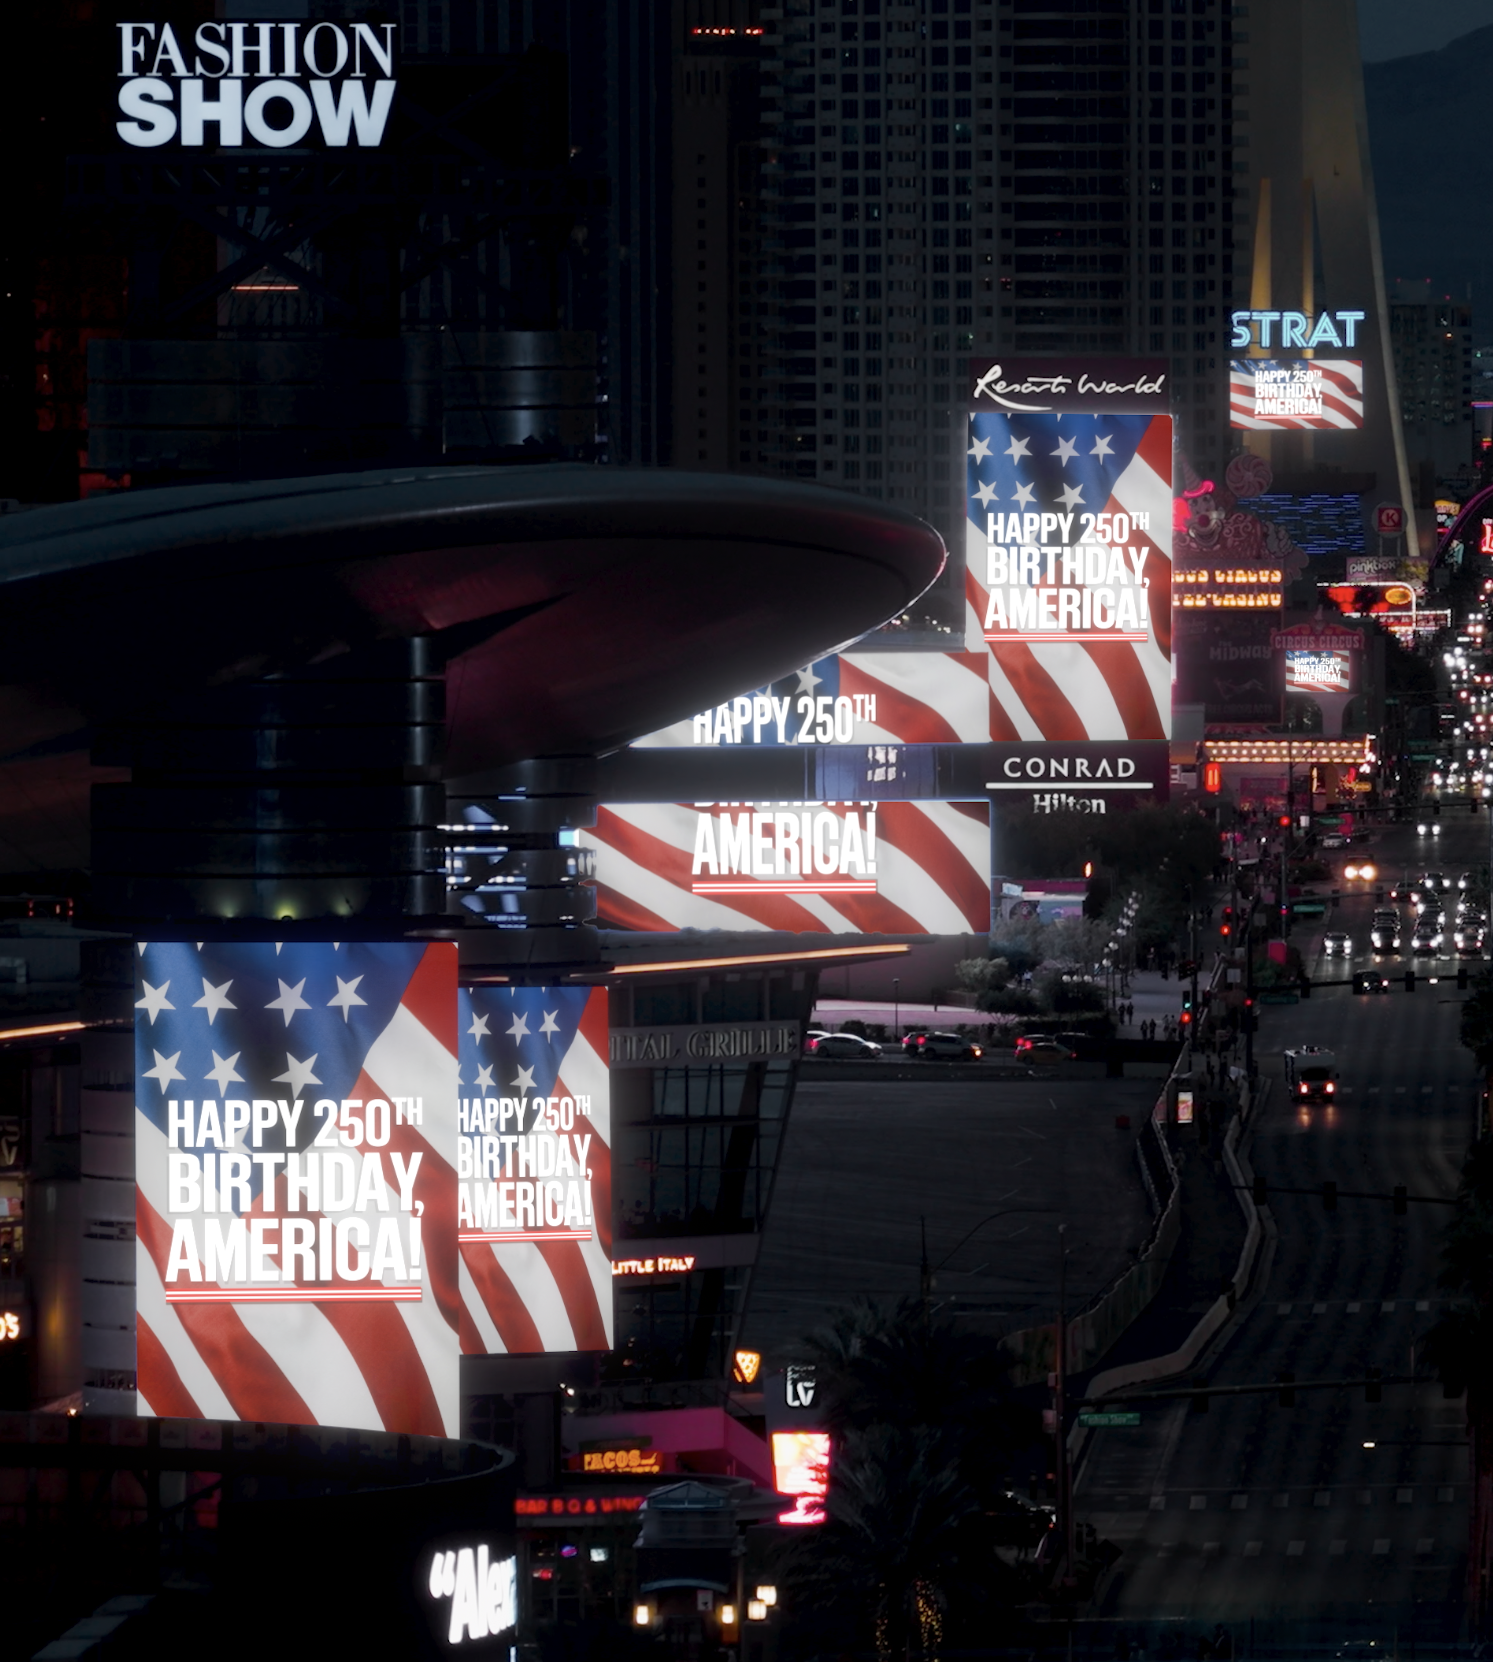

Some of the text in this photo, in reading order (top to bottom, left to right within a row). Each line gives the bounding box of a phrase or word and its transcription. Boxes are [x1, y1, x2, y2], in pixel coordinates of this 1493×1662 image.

[117, 22, 396, 78] FASHION
[117, 77, 396, 147] SHOW
[1231, 311, 1365, 348] STRAT
[974, 363, 1166, 411] Resorts World
[1255, 370, 1291, 382] HAPPY
[1255, 382, 1323, 399] BIRTHDAY,
[1254, 399, 1322, 415] AMERICA!
[987, 513, 1074, 544] HAPPY
[987, 547, 1150, 588] BIRTHDAY,
[1349, 559, 1396, 575] pinkbox
[984, 588, 1148, 629] AMERICA!
[1274, 635, 1360, 648] CIRCUS CIRCUS
[693, 696, 791, 744] HAPPY
[1003, 757, 1136, 778] CONRAD
[1032, 793, 1106, 814] Hilton
[692, 811, 877, 875] AMERICA!
[610, 1027, 797, 1062] ITAL GRILLE
[169, 1097, 423, 1148] HAPPY 250TH
[457, 1098, 528, 1132] HAPPY
[457, 1134, 593, 1180] BIRTHDAY,
[168, 1153, 425, 1217] BIRTHDAY,
[458, 1181, 592, 1229] AMERICA!
[165, 1217, 422, 1283] AMERICA!
[611, 1256, 695, 1275] LITTLE ITALY
[515, 1498, 548, 1514] BAR
